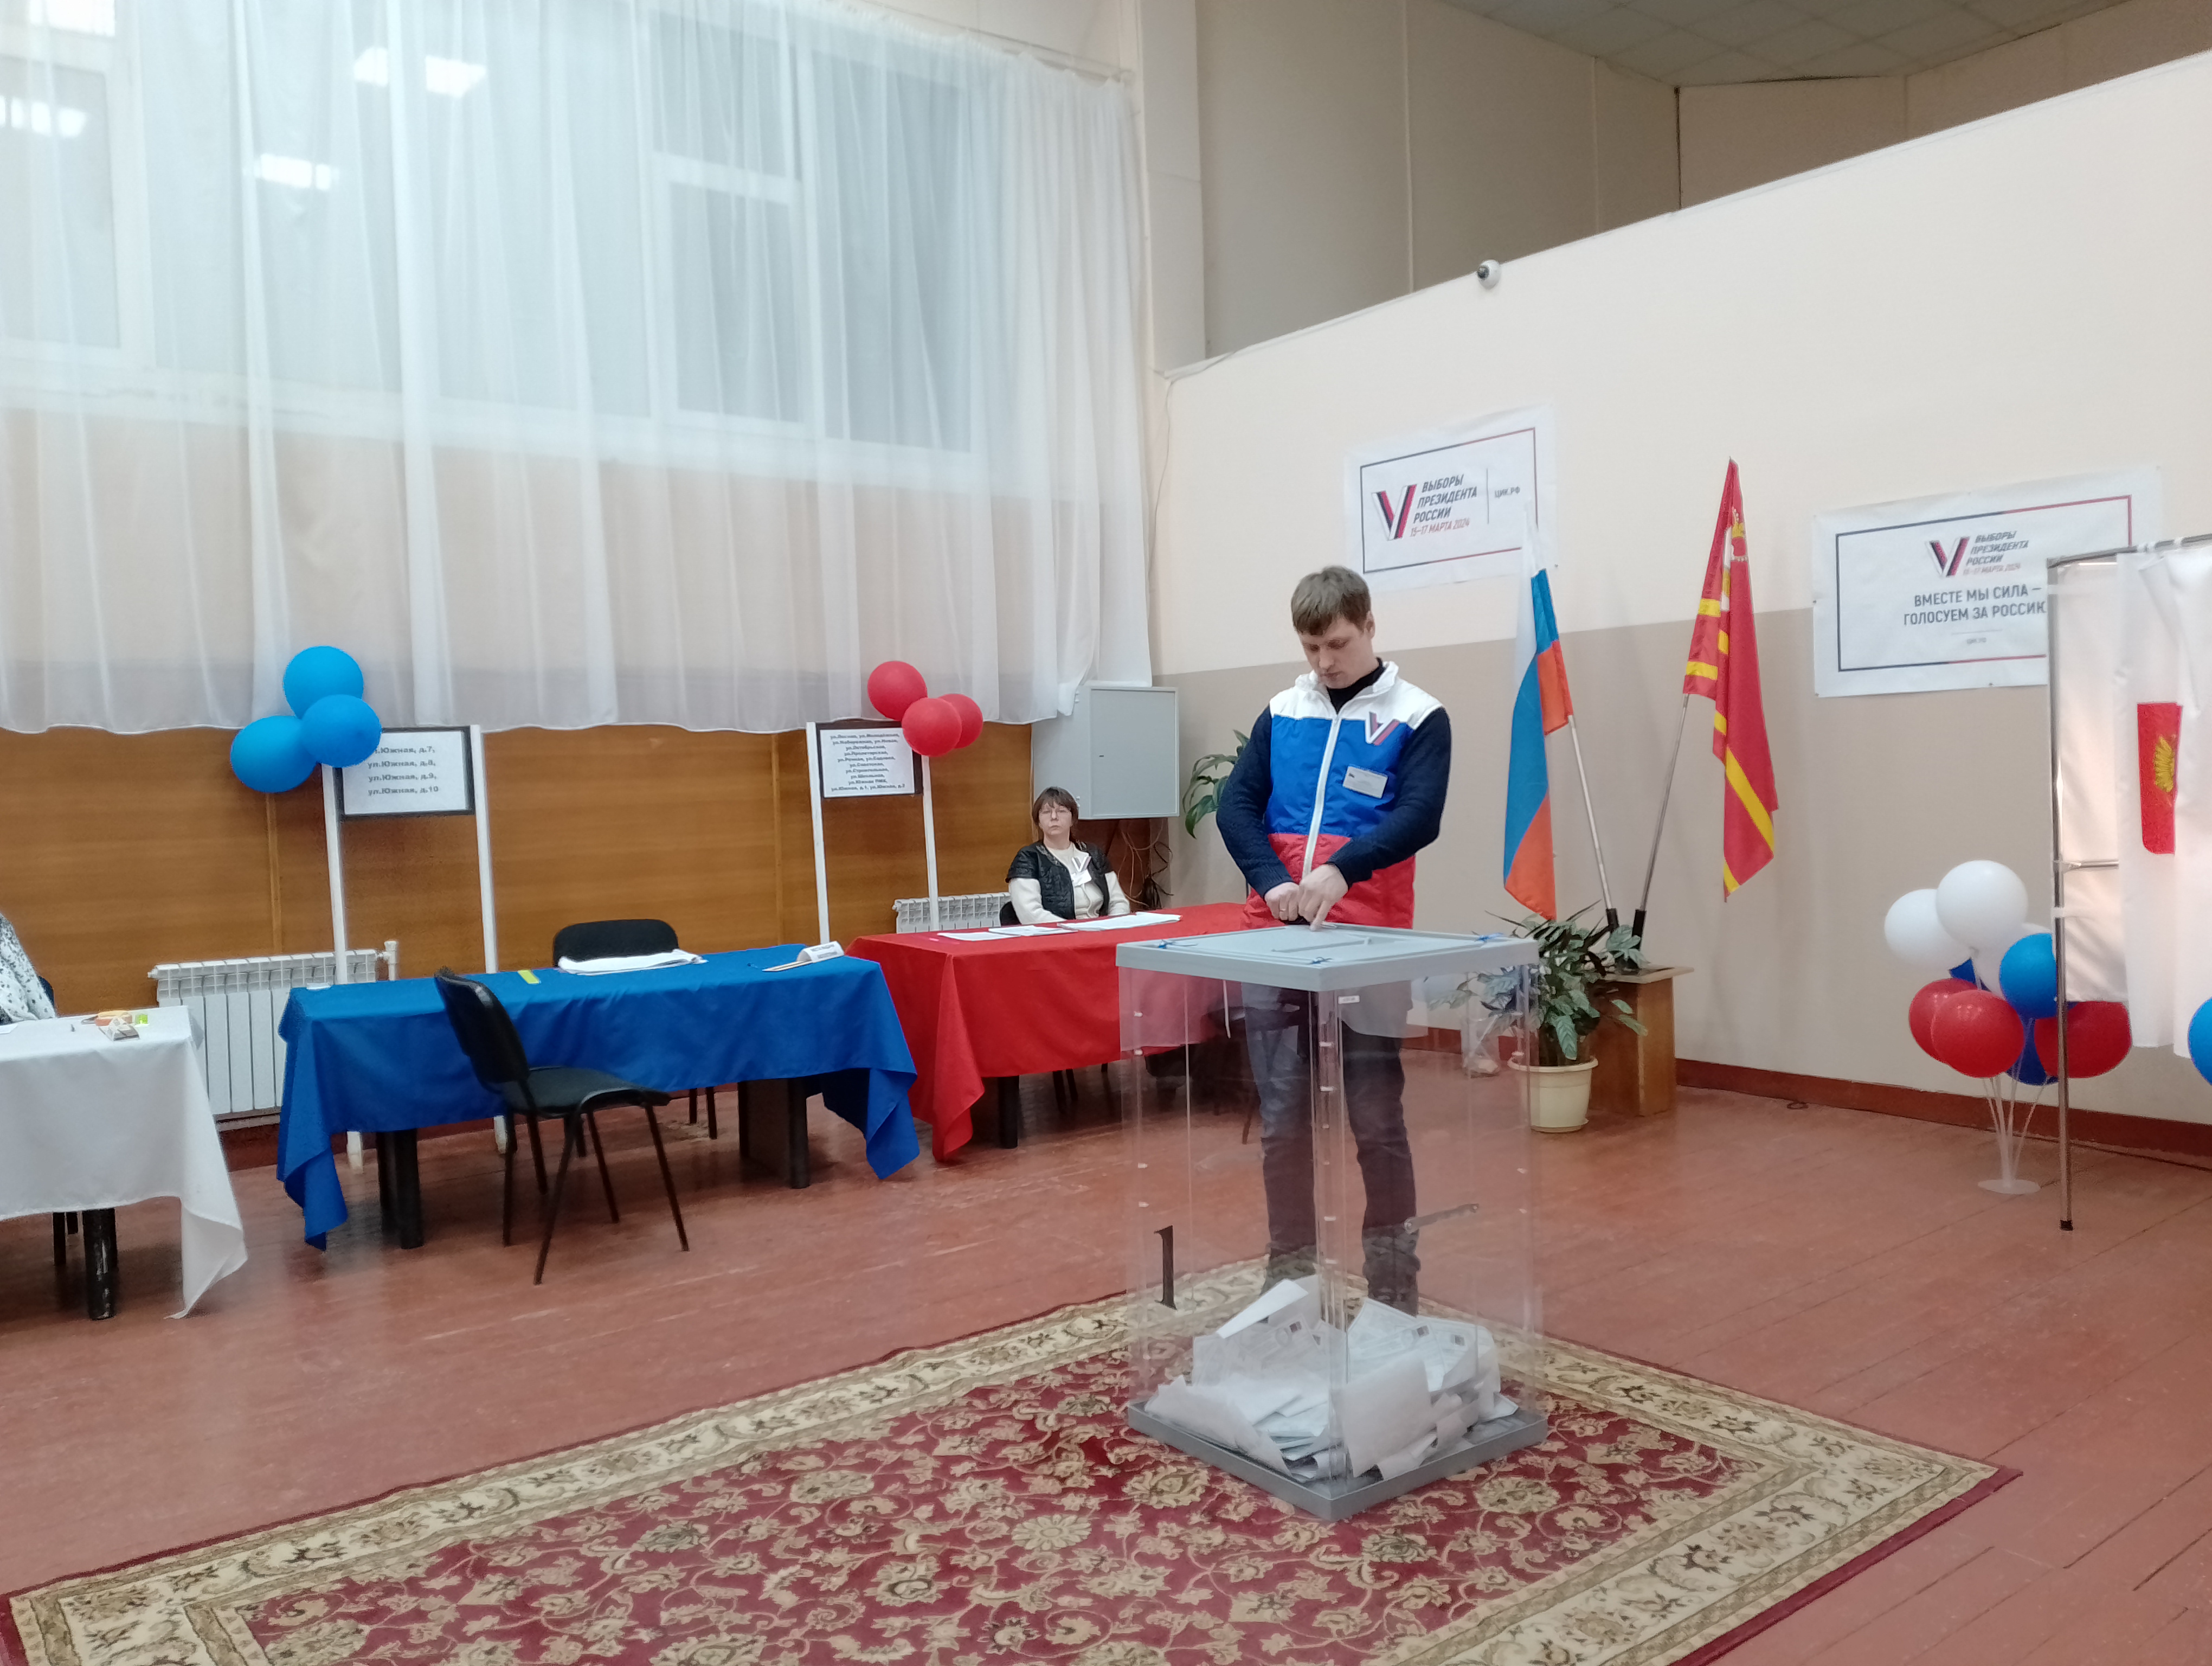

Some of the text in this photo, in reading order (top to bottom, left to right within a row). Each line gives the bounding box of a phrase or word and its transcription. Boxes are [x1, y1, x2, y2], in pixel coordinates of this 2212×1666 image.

[1422, 474, 1464, 493] ВЫБОРЫ
[1494, 486, 1520, 498] ЦИК.РФ
[1417, 486, 1477, 509] ПРЕЗИДЕНТА
[1413, 506, 1451, 524] РОССИИ
[1429, 520, 1452, 534] МАРТА
[1970, 540, 2029, 554] ПРЕЗИДЕНТА
[1966, 553, 2004, 566] РОССИИ
[1914, 590, 1963, 607] ВМЕСТЕ
[1966, 588, 1989, 602] МЫ
[1993, 584, 2028, 599] СИЛА
[1904, 608, 1969, 626] ГОЛОСУЕМ
[1972, 607, 1988, 619] ЗА
